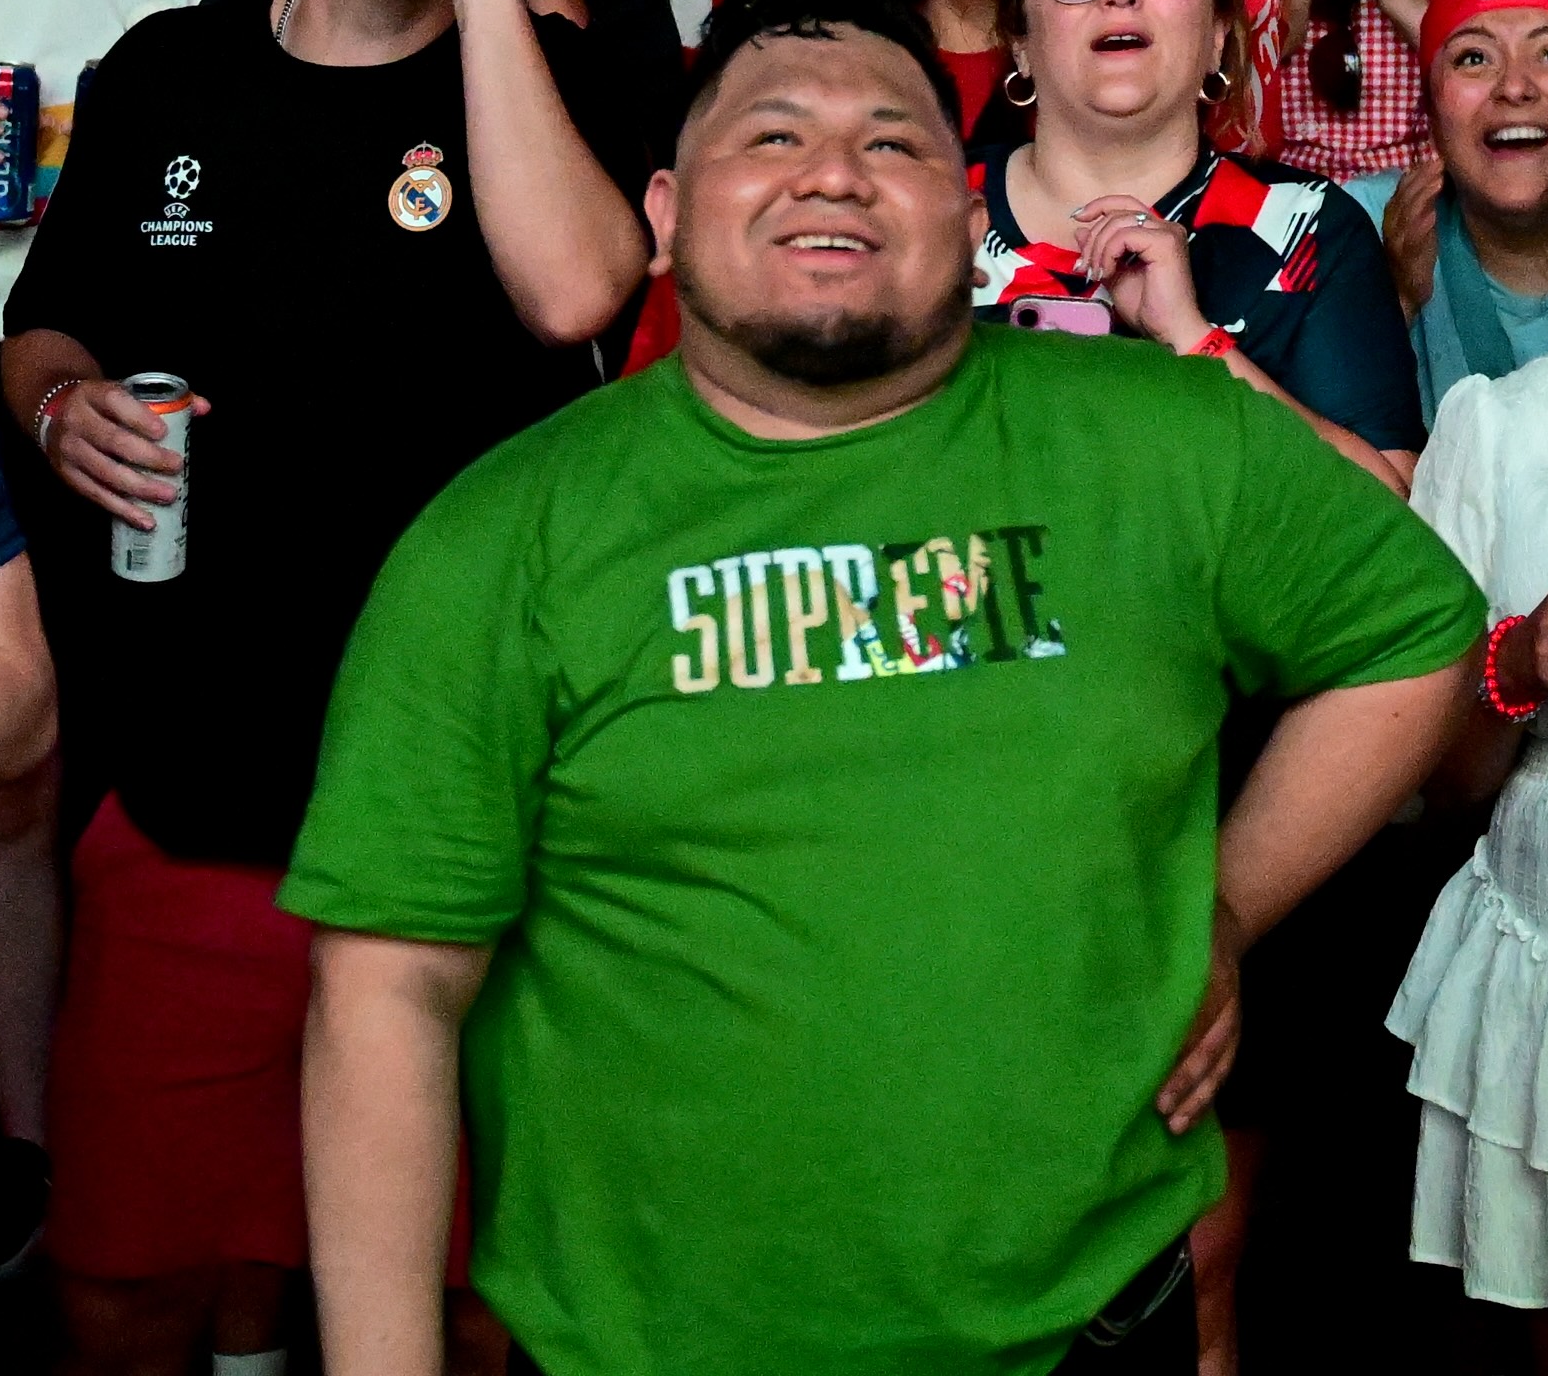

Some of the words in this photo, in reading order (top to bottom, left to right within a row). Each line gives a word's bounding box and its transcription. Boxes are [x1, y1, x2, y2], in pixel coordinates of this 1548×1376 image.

[140, 220, 214, 234] CHAMPIONS
[150, 234, 198, 247] LEAGUE
[666, 524, 1067, 695] SUPREME
